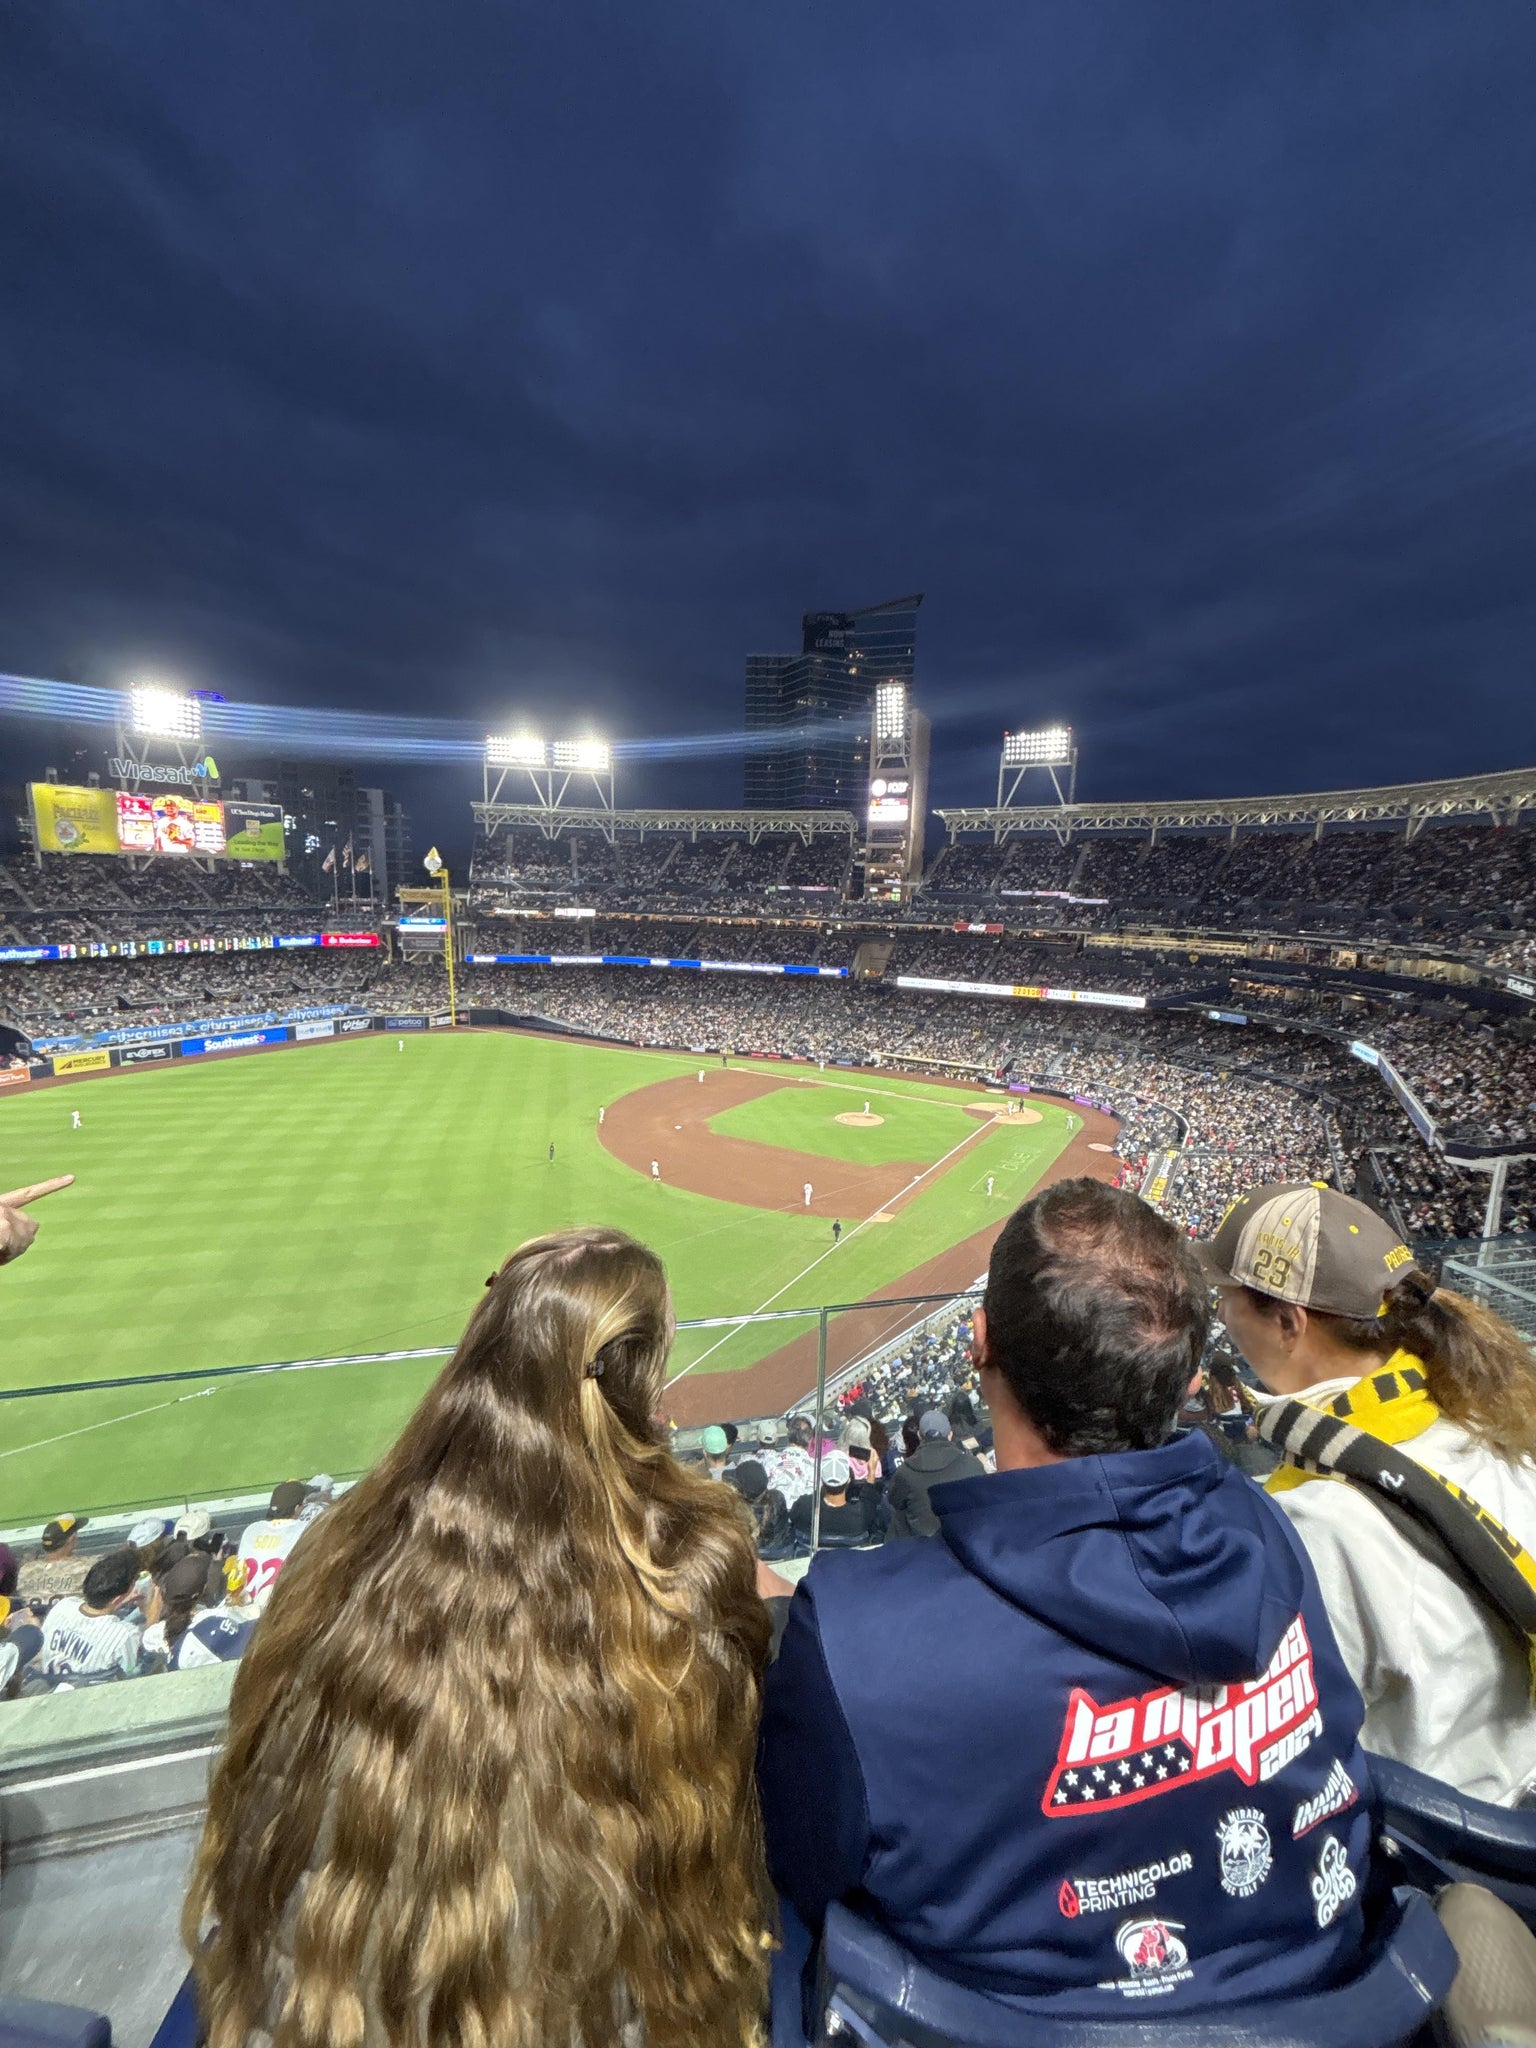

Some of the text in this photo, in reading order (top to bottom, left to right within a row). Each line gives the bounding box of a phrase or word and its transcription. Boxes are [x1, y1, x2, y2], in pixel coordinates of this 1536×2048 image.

[112, 758, 192, 785] Viasat
[1285, 940, 1327, 950] COLEMAN
[398, 1018, 422, 1028] petco
[204, 1034, 260, 1051] Southwest
[73, 1055, 106, 1064] MERCURY
[1253, 1249, 1291, 1288] 23
[50, 1629, 93, 1664] GWYNN
[1066, 1699, 1135, 1763] la
[1197, 1658, 1315, 1777] open
[1259, 1708, 1323, 1781] 2024
[1215, 1808, 1265, 1839] LA MIRADA
[1074, 1853, 1193, 1897] TECHNICOLOR
[1220, 1856, 1274, 1897] DISC GOLF CLUB
[1078, 1882, 1156, 1914] PRINTING
